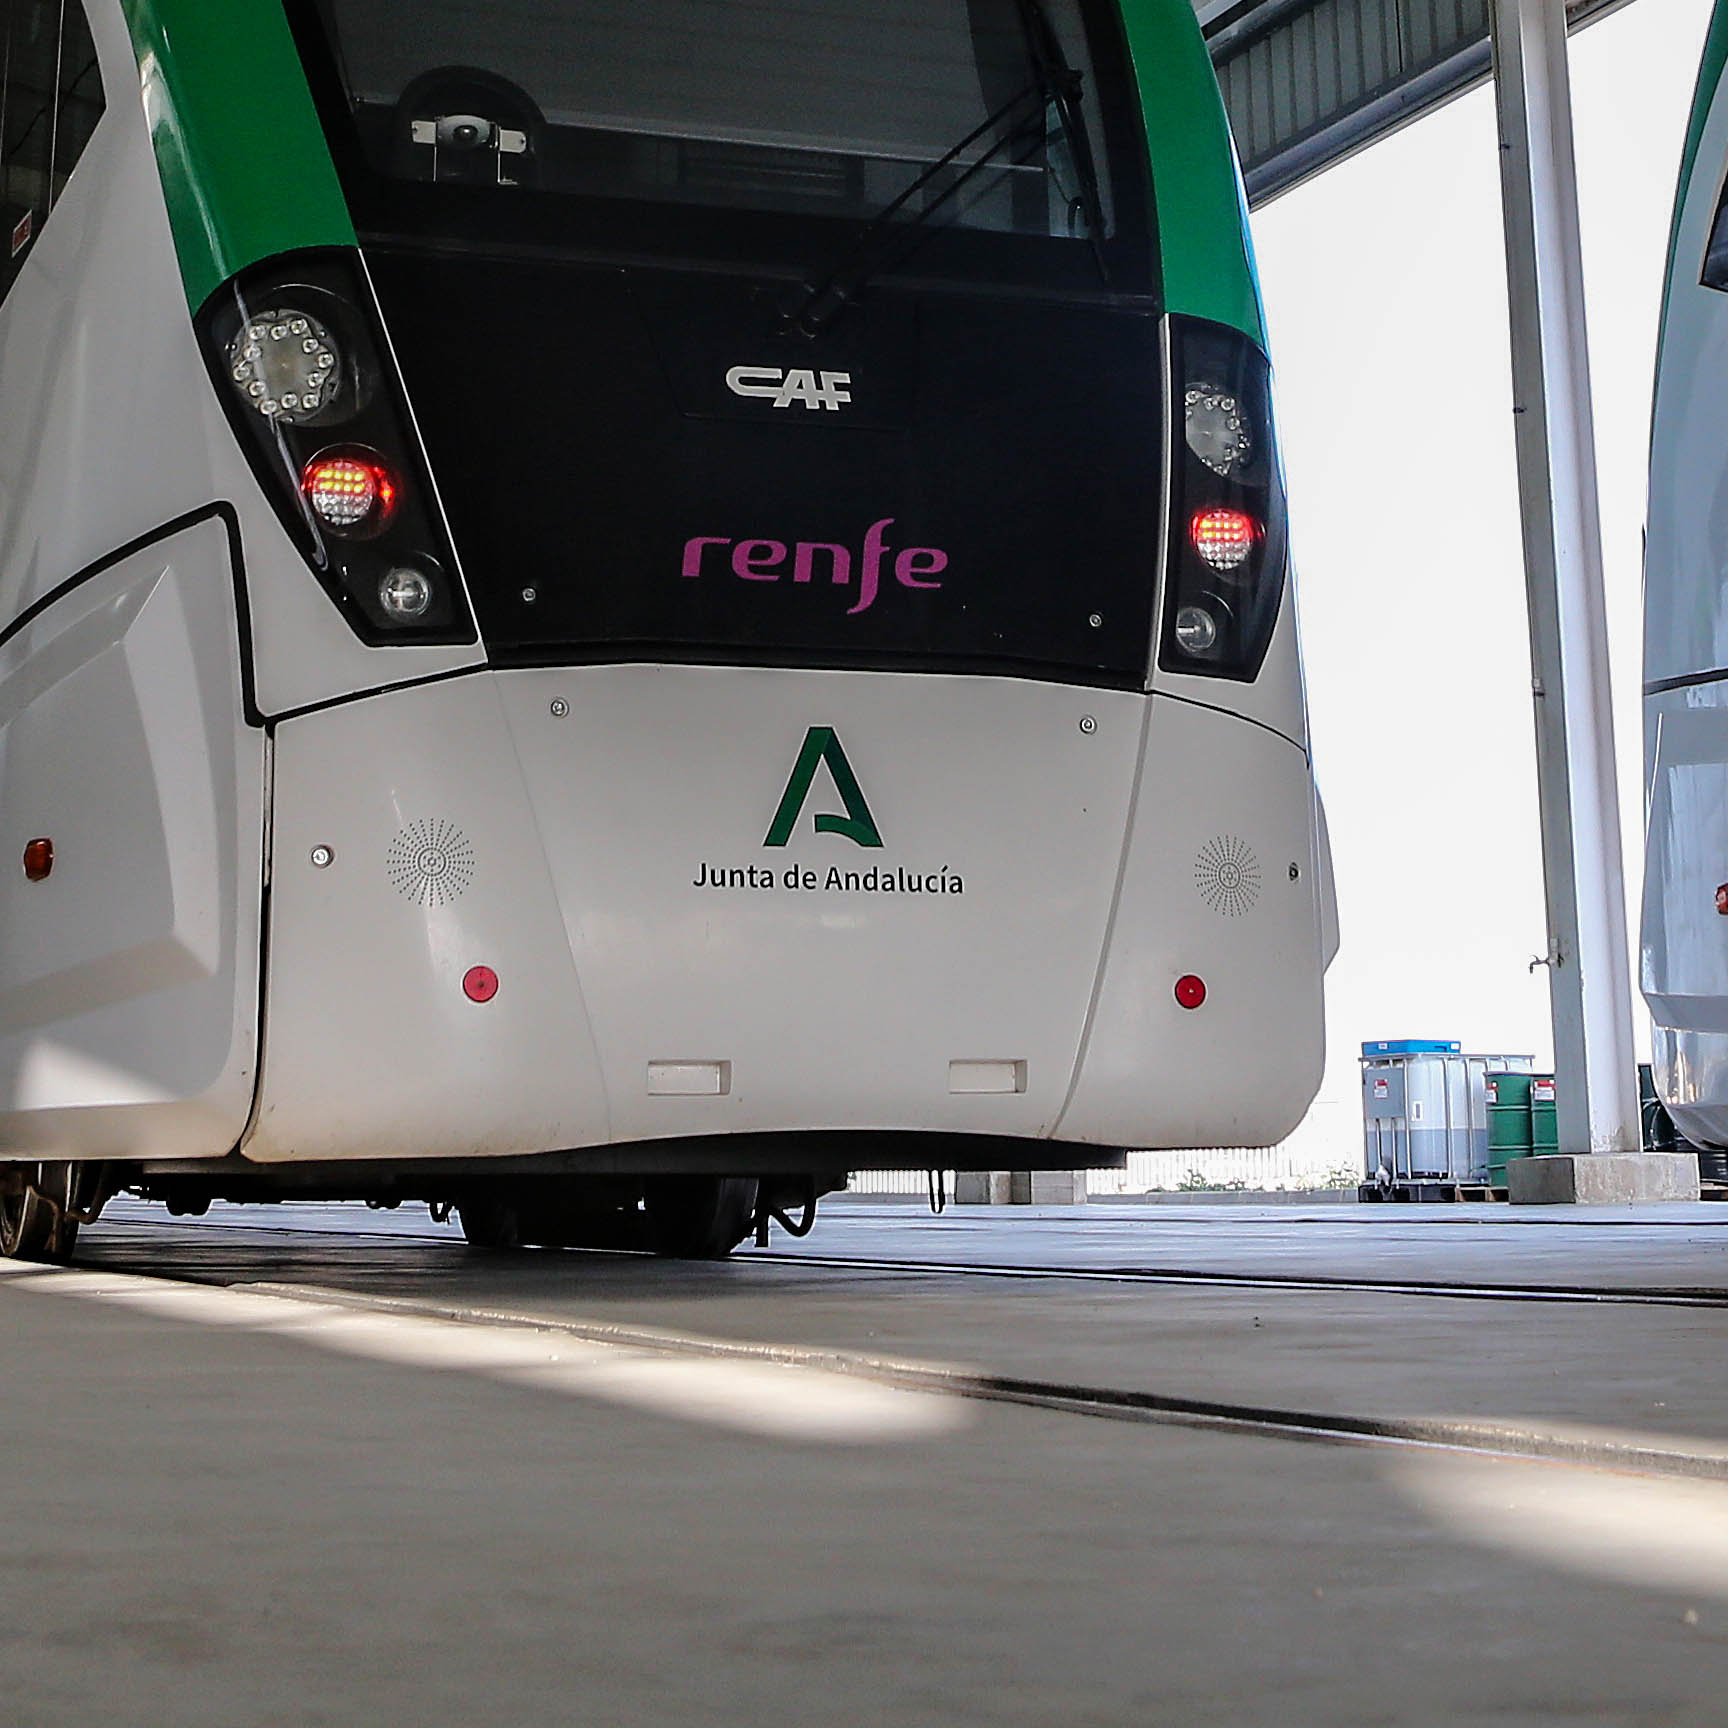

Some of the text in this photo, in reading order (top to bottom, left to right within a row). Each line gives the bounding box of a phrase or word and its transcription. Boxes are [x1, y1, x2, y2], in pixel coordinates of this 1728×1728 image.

[725, 365, 852, 411] CAF
[681, 517, 949, 615] renfe
[692, 862, 964, 894] Junta de Andalucía
